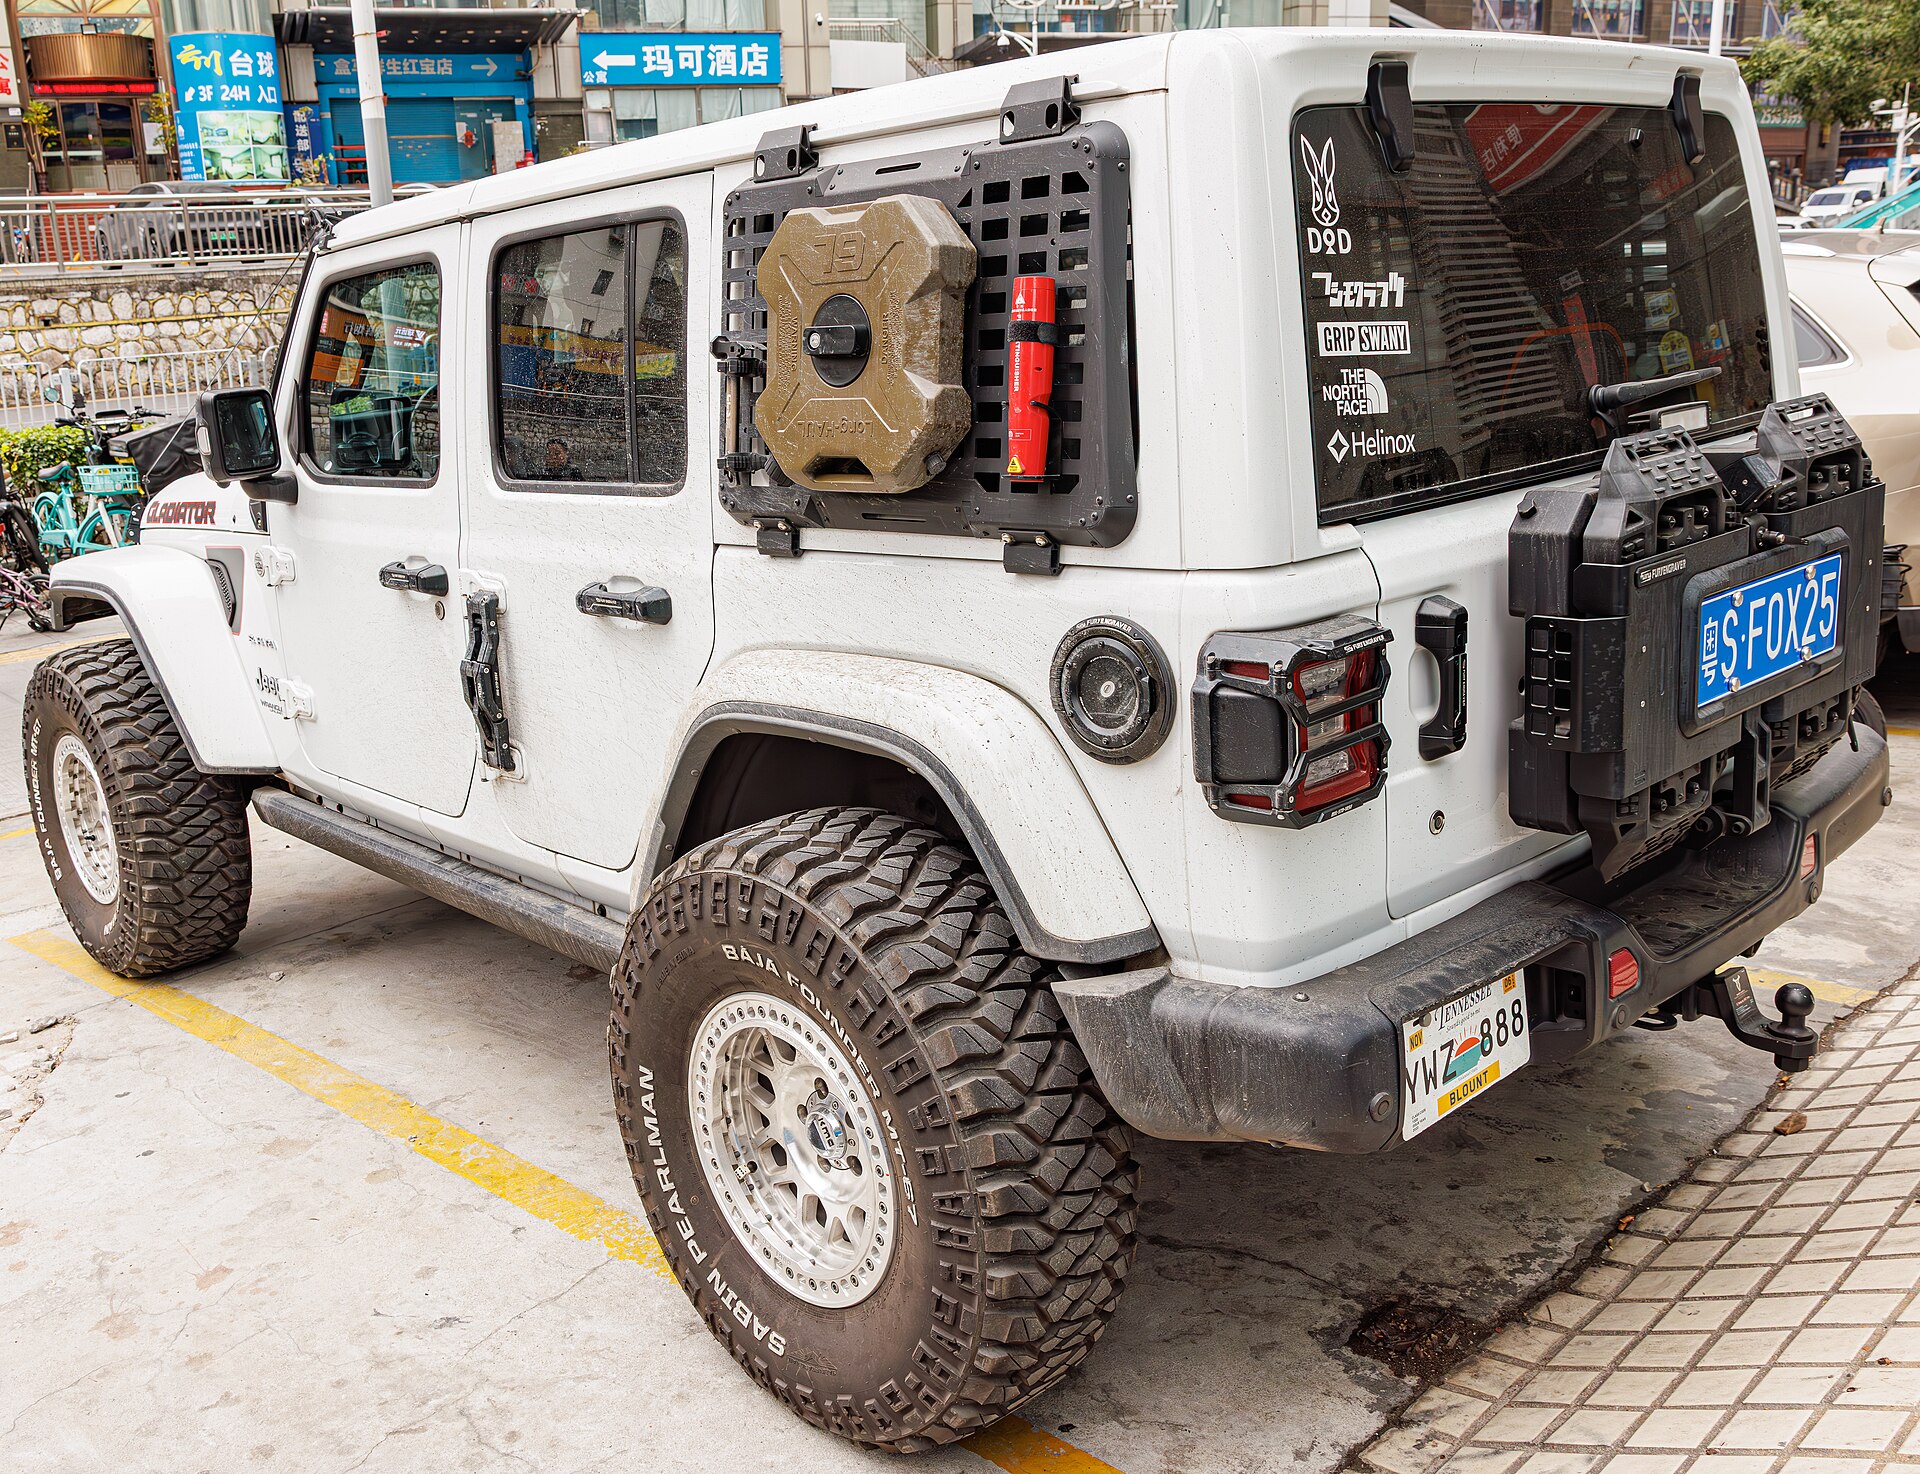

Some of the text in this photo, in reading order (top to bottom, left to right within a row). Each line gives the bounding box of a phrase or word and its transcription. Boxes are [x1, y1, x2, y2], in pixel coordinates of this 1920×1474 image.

[229, 49, 275, 77] 台球
[334, 58, 453, 75] 盒生红宝店
[642, 43, 769, 77] 玛可酒店
[583, 71, 608, 84] 公寓
[198, 85, 278, 103] 3F 24H 入口
[1307, 228, 1352, 254] DOD
[881, 312, 889, 365] DANGER
[1323, 325, 1405, 352] GRIP SWANY
[1340, 368, 1365, 384] THE
[1322, 384, 1367, 401] NORTH
[1336, 399, 1368, 416] FACE
[1351, 428, 1416, 457] Helinox
[146, 501, 217, 525] GLADIATOR
[31, 760, 48, 833] FOUNDER
[45, 837, 63, 881] BAJA
[1434, 984, 1492, 1031] TENNESSEE
[720, 943, 779, 980] BAJA
[786, 968, 883, 1101] FOUNDER
[1480, 998, 1524, 1058] 888
[1409, 1033, 1423, 1049] NOV
[1449, 1069, 1488, 1106] BLOUNT
[637, 1064, 787, 1357] SABIN PEARLMAN
